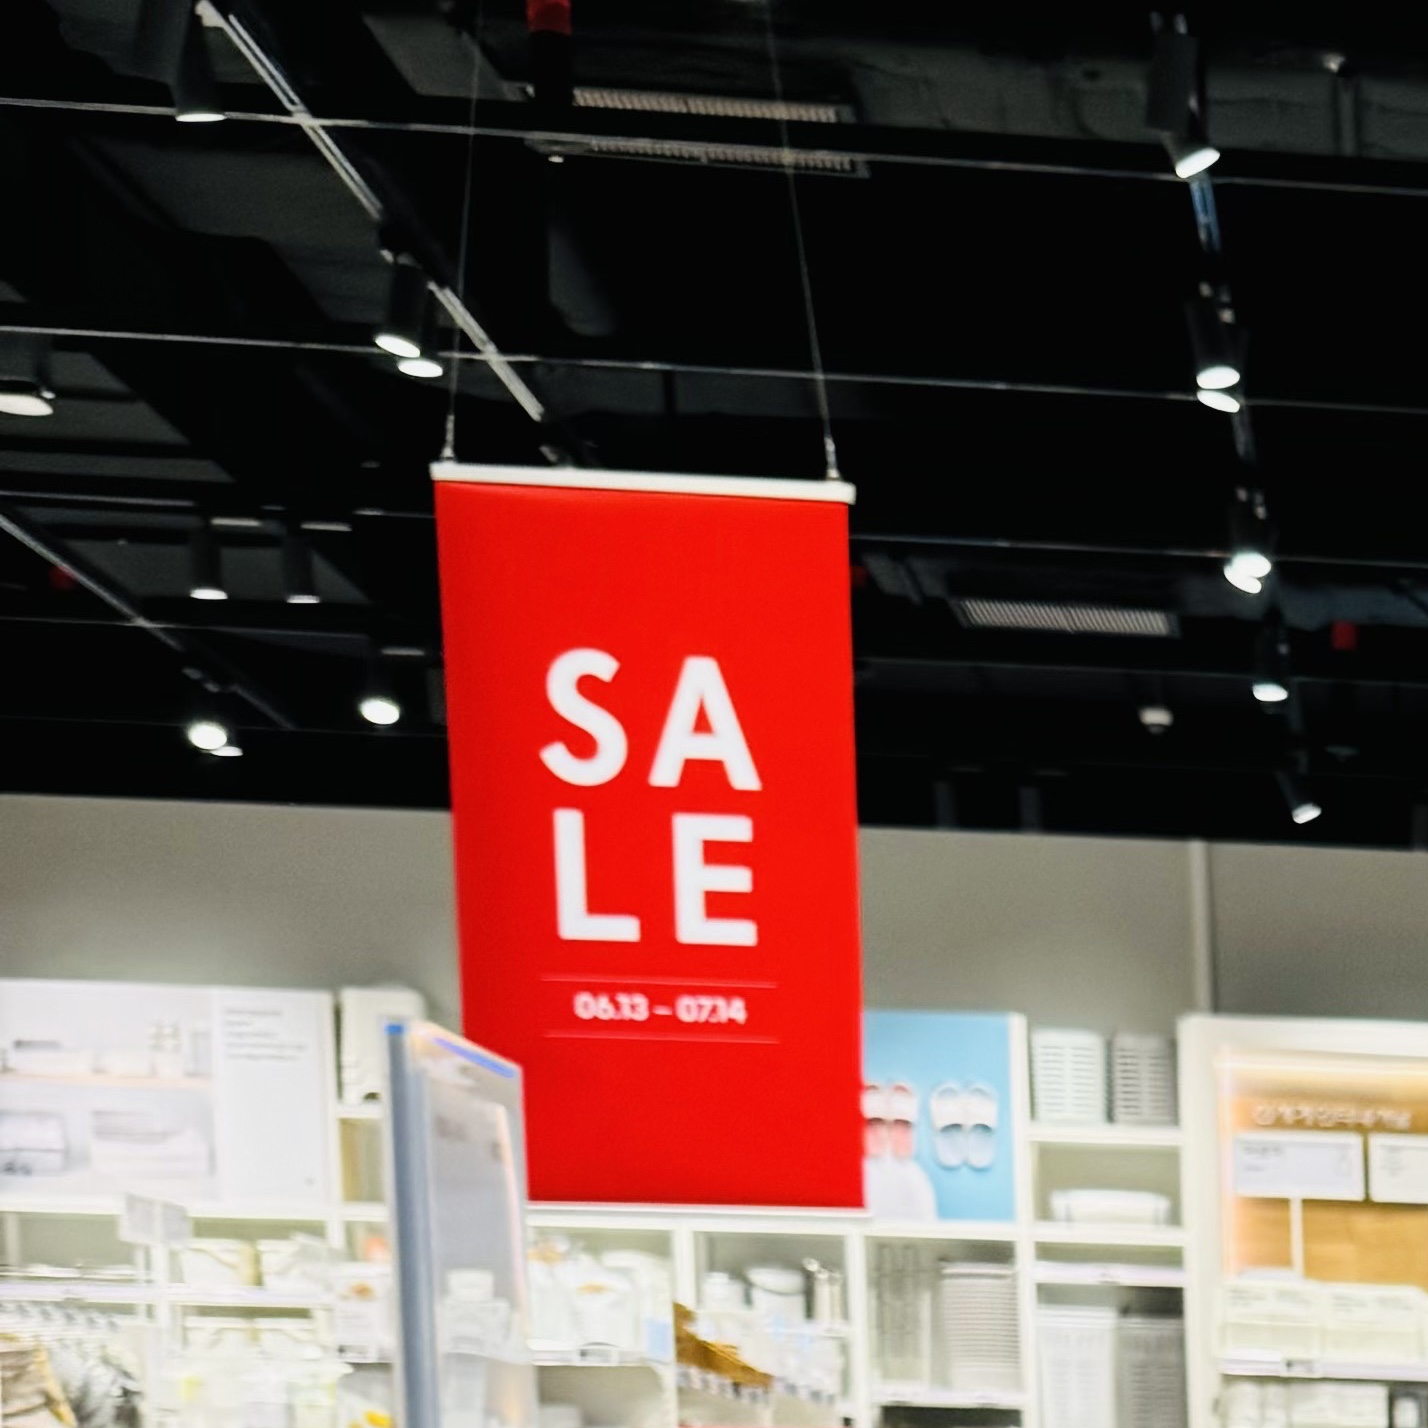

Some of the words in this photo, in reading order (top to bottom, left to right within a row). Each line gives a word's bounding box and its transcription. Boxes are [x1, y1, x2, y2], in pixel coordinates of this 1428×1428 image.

[540, 647, 763, 791] SA
[553, 808, 759, 948] LE
[573, 990, 650, 1022] 06.13
[675, 994, 748, 1025] 07.14
